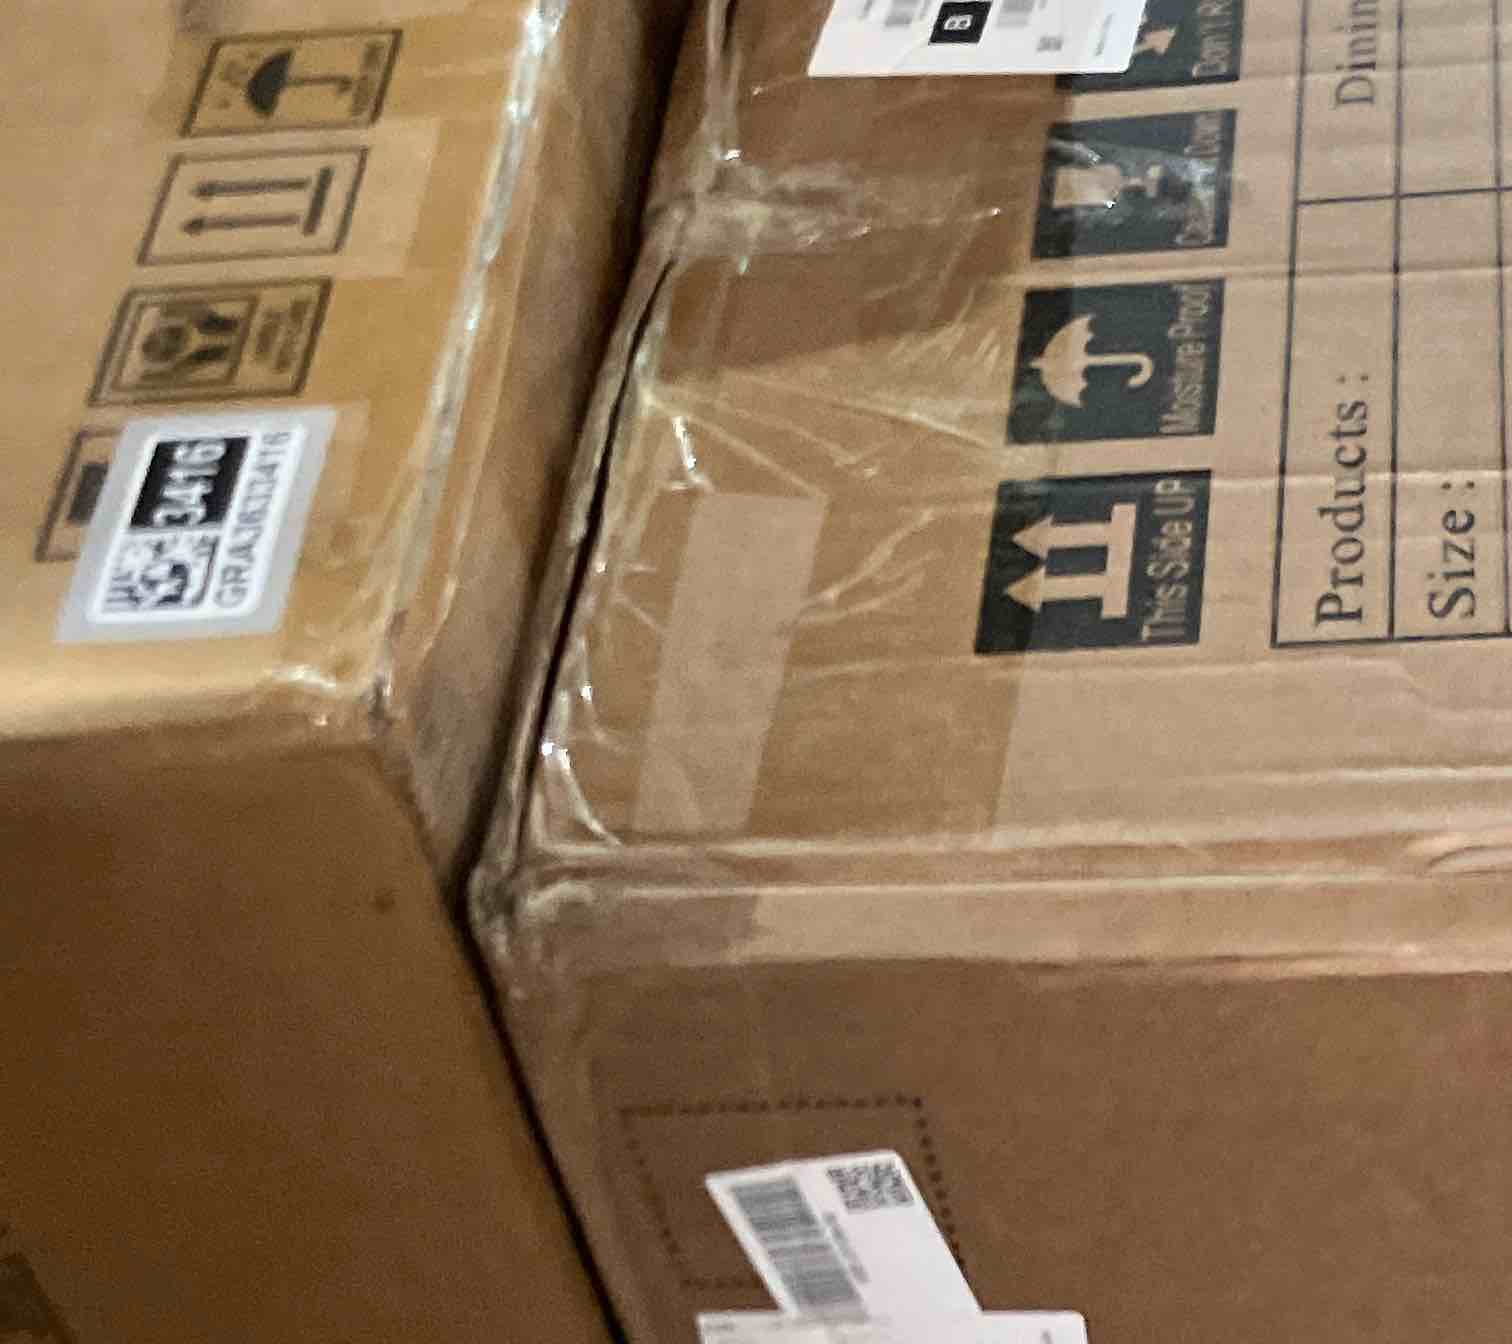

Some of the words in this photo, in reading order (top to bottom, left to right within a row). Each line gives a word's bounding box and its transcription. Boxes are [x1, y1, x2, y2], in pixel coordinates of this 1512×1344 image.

[154, 436, 227, 528] 3416
[1156, 479, 1197, 517] UP
[1147, 518, 1194, 579] Side
[1142, 580, 1189, 643] This
